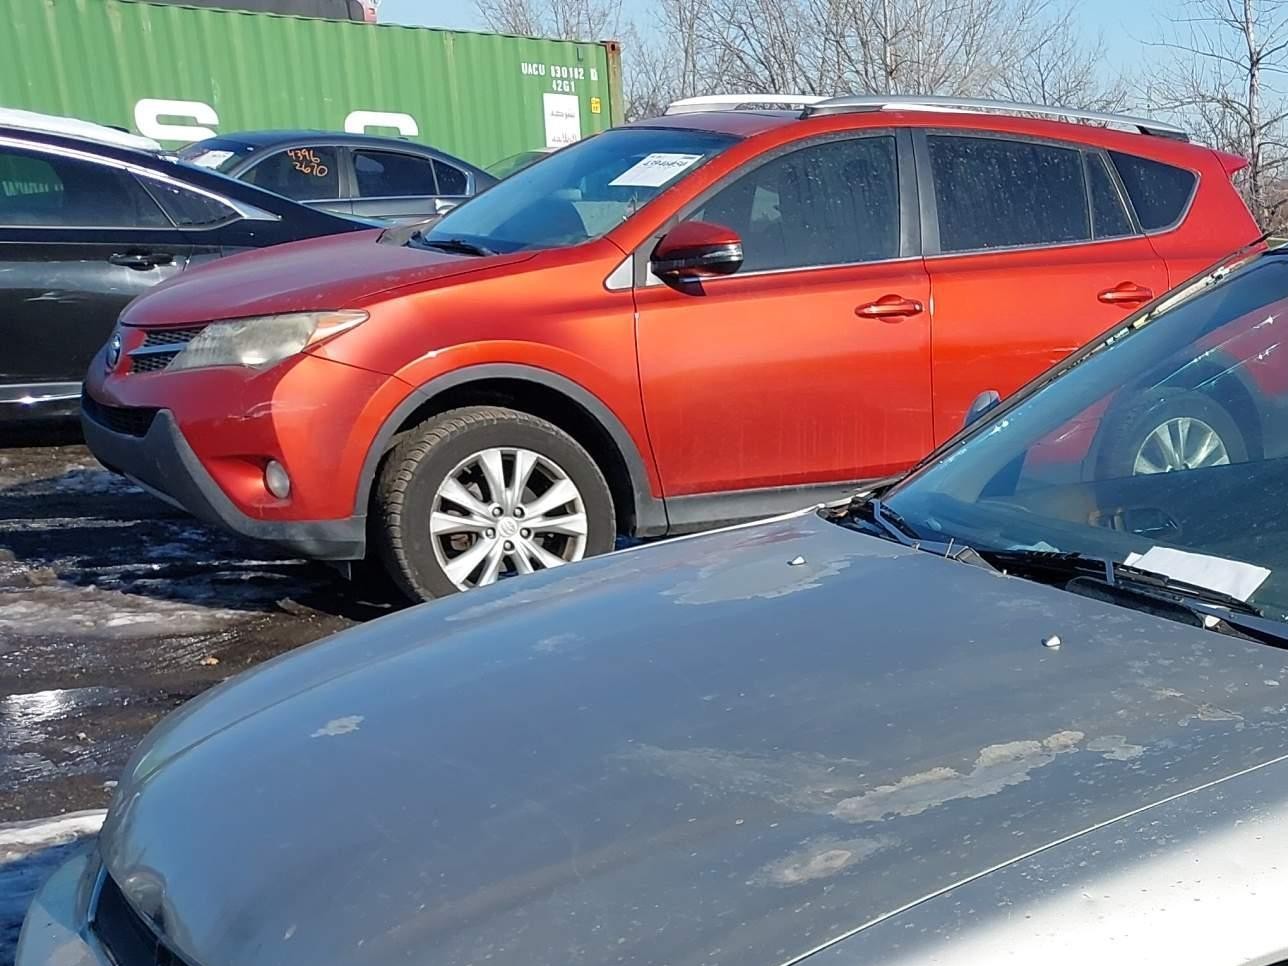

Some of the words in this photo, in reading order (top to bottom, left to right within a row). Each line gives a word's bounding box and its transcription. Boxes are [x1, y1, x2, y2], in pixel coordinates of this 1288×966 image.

[521, 62, 545, 76] UACU
[552, 80, 575, 93] 42G1
[287, 148, 321, 163] 4396
[293, 160, 328, 177] 2670
